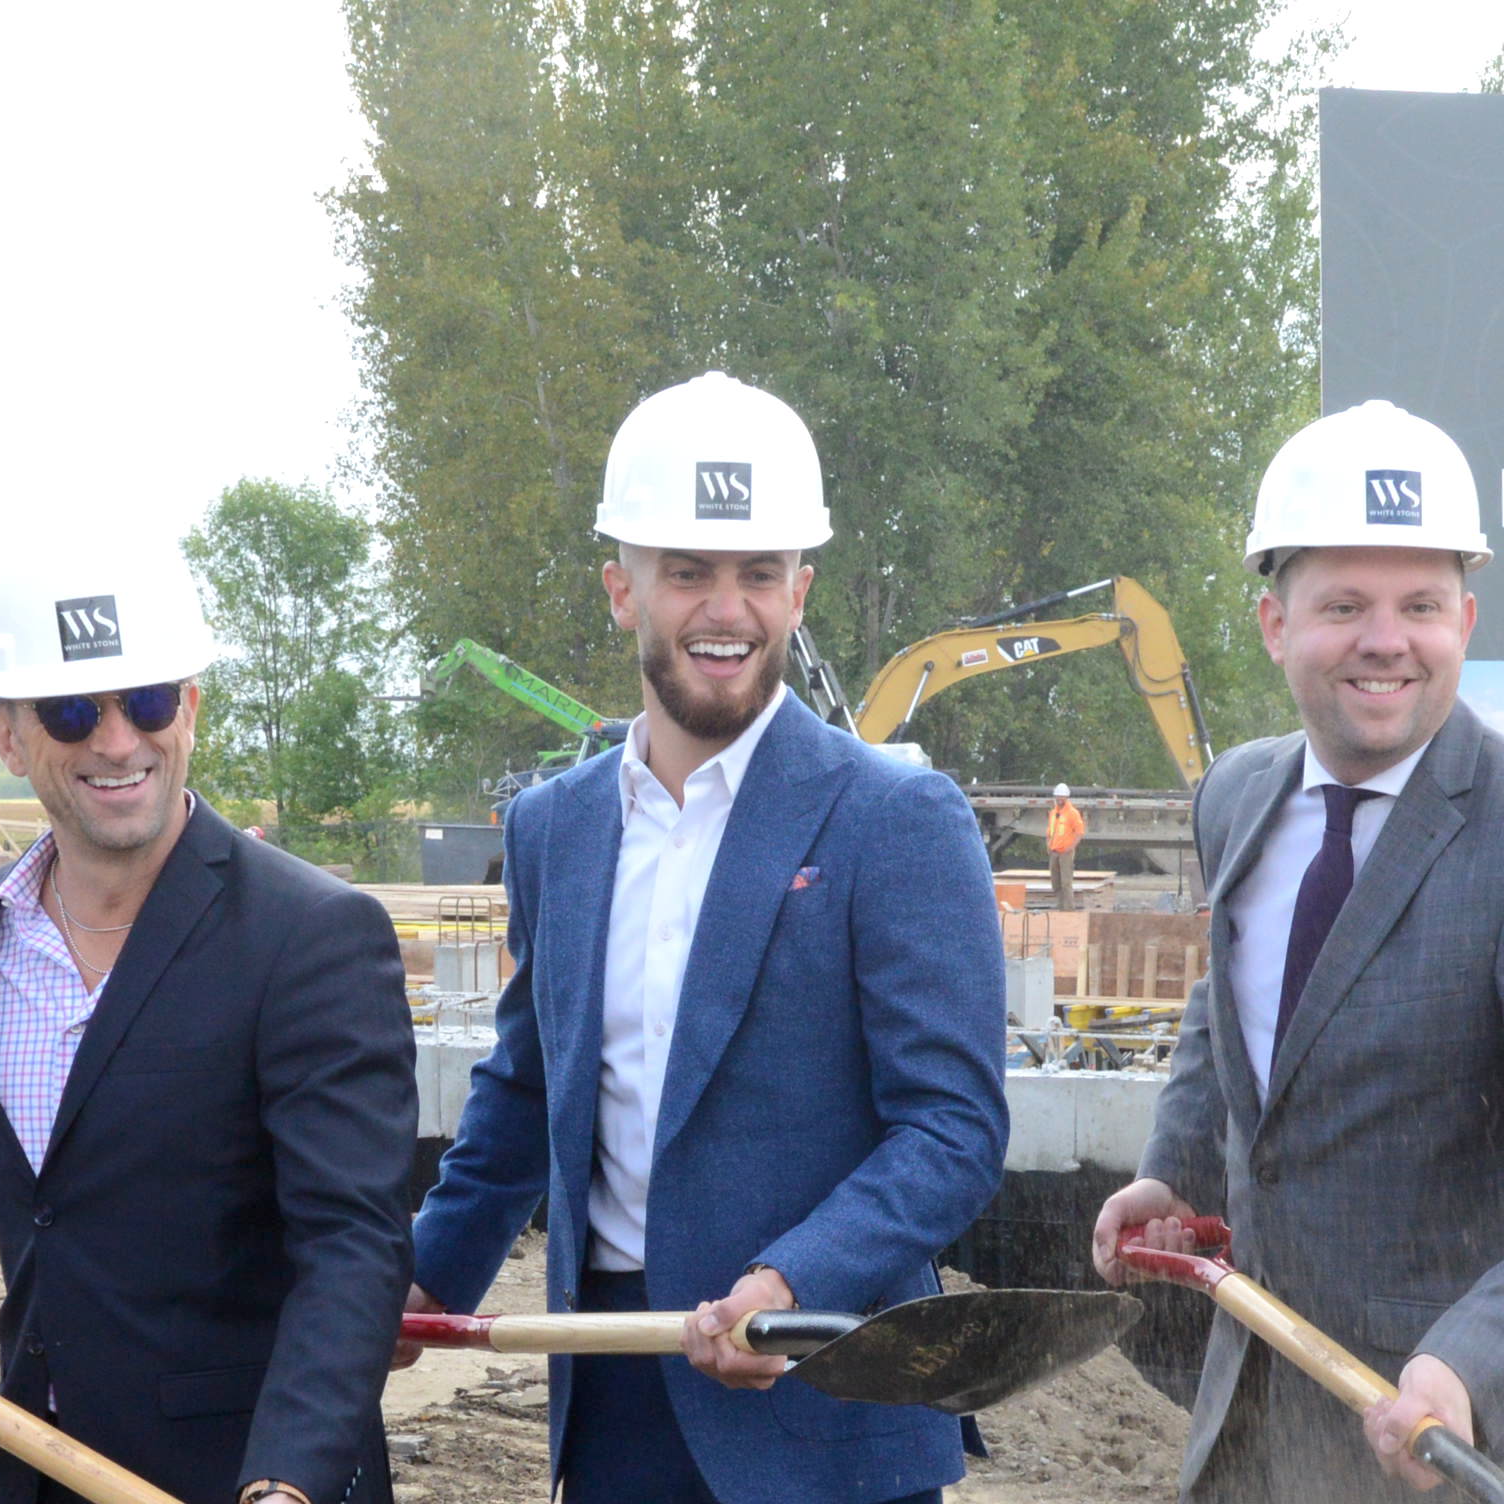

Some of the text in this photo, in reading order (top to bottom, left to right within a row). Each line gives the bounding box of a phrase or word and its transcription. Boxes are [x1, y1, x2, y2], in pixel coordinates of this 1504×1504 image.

[700, 471, 750, 501] WS
[1369, 479, 1420, 508] WS
[60, 606, 117, 640] WS
[65, 639, 120, 652] WHITE STONE
[1013, 637, 1040, 659] CAT
